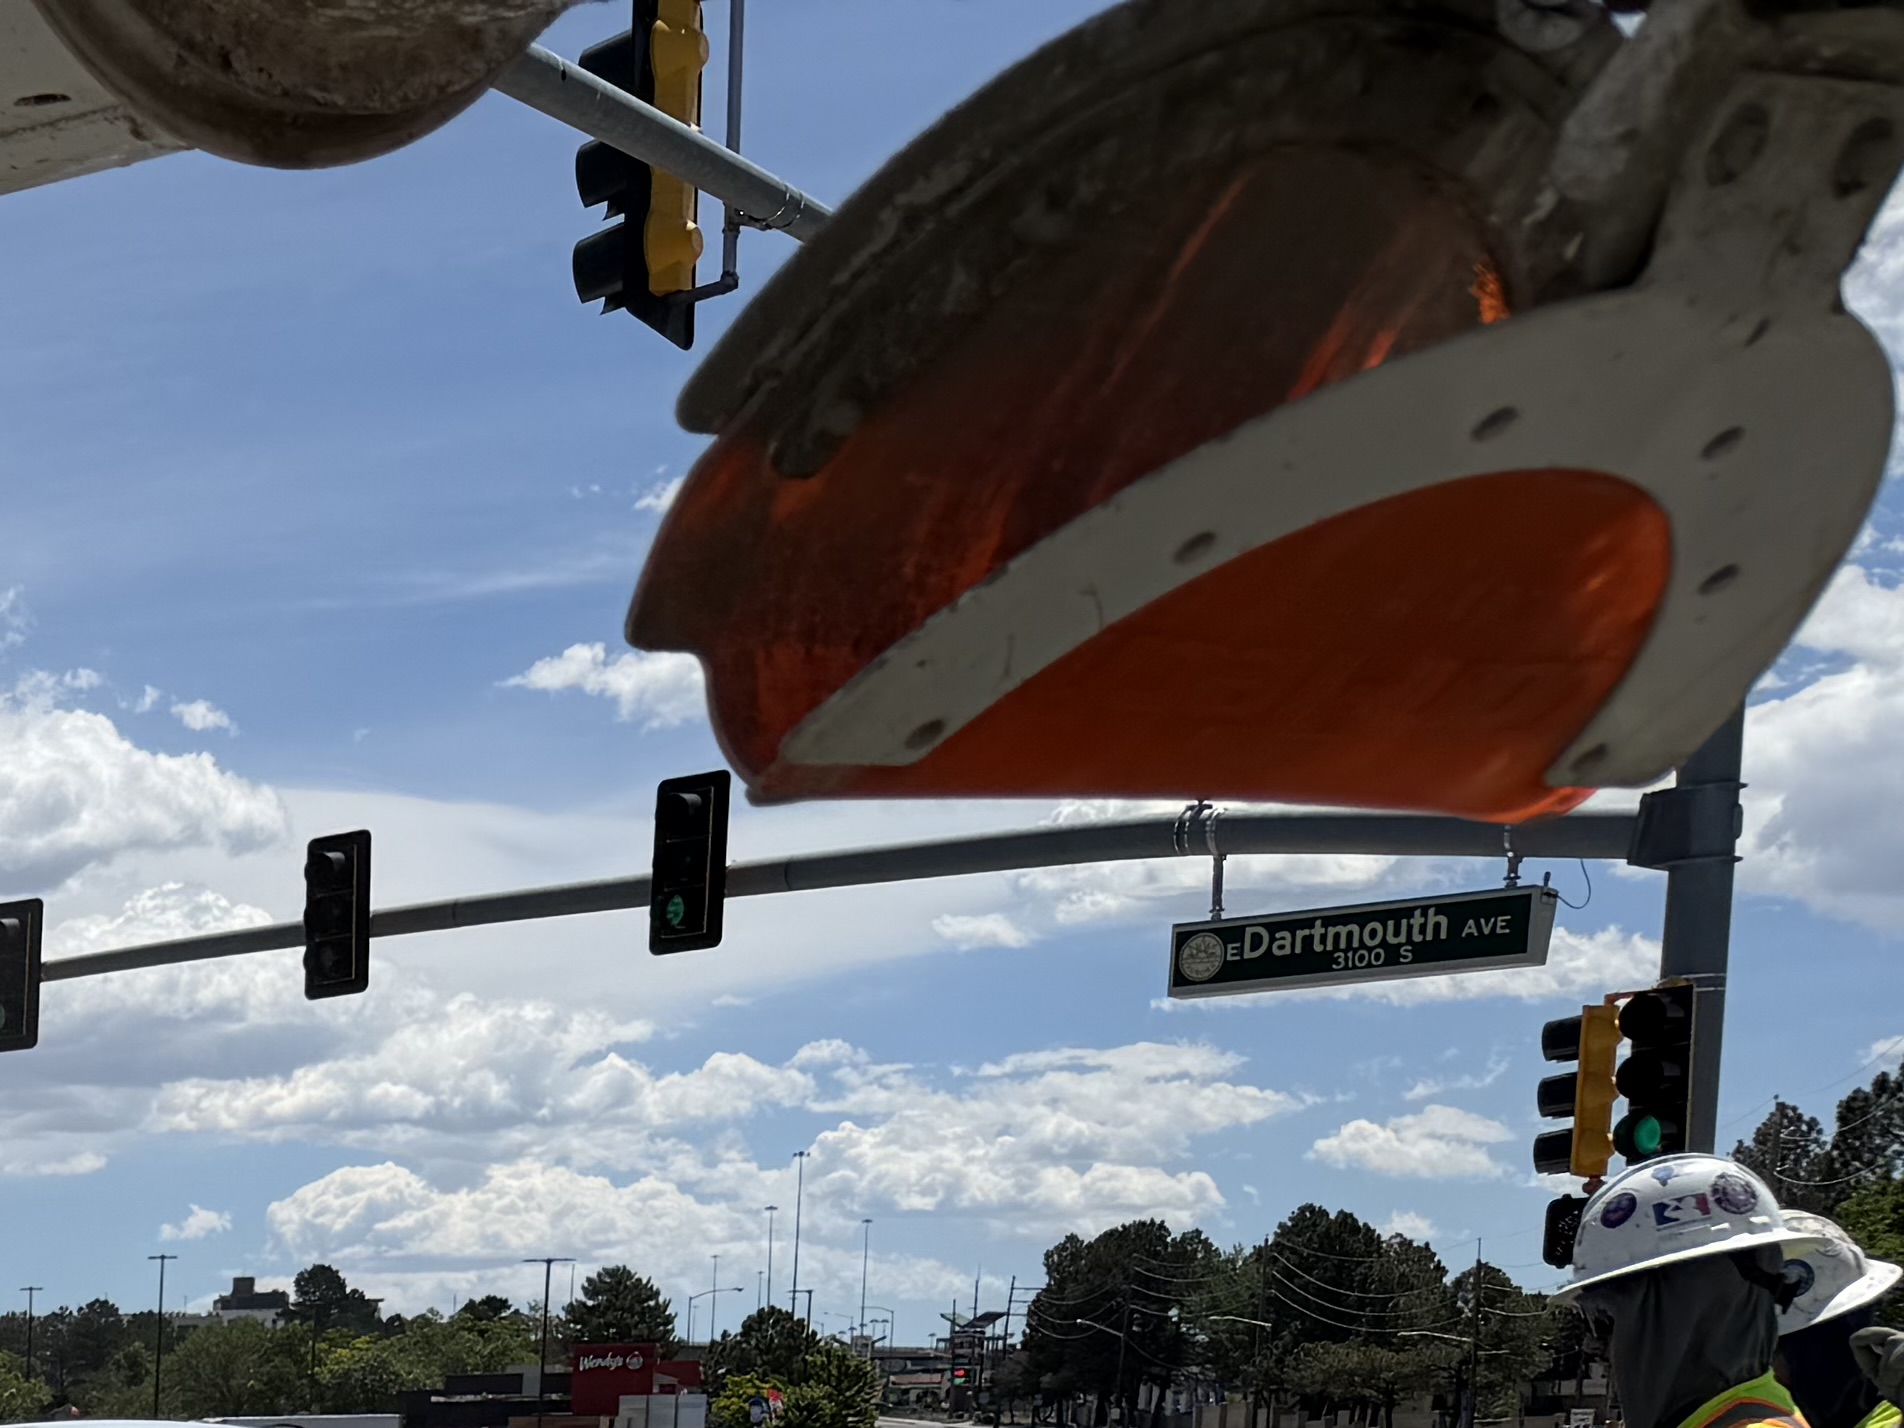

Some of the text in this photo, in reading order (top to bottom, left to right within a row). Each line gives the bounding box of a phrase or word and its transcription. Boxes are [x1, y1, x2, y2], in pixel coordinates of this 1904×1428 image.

[1226, 907, 1512, 962] E Dartmouth AVE
[1332, 945, 1413, 970] 3100 S
[579, 1351, 624, 1372] Wendy's
